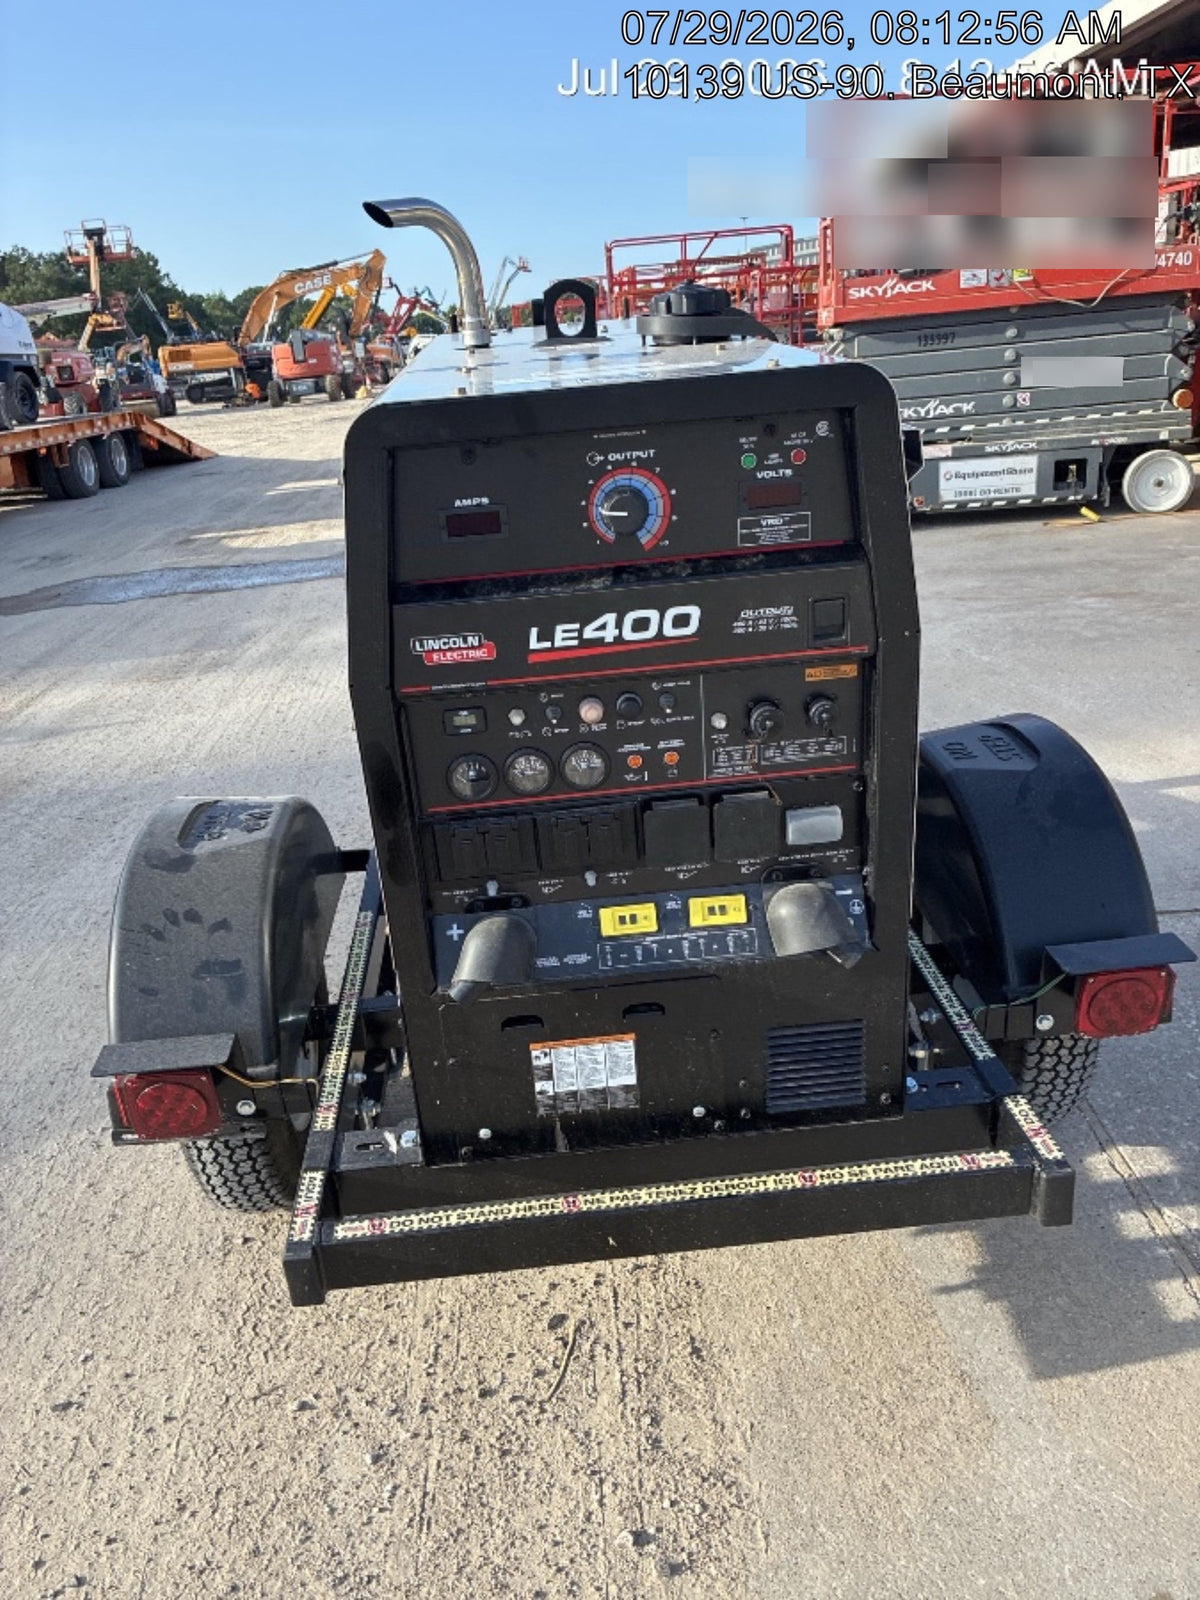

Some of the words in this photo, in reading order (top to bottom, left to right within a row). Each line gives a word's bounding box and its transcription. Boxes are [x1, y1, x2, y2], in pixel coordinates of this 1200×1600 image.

[1155, 250, 1193, 268] 4740
[294, 273, 331, 294] CASE
[848, 277, 936, 299] SKYJACK
[607, 449, 656, 461] OUTPUT
[985, 440, 1038, 453] SKYJACK
[756, 468, 793, 479] VOLTS
[454, 496, 490, 508] AMPS
[529, 605, 701, 650] LE400
[414, 634, 480, 651] LINCOLN
[432, 648, 489, 663] ELECTRIC
[819, 1171, 844, 1181] NO
[847, 1168, 869, 1177] SE
[872, 1164, 915, 1175] PARE
[609, 1193, 642, 1204] PAS
[648, 1187, 698, 1199] TENEZ
[773, 1178, 795, 1187] ICI
[389, 1219, 414, 1229] DO
[418, 1213, 453, 1224] NOT
[456, 1206, 512, 1220] STAND
[515, 1202, 561, 1214] HERE
